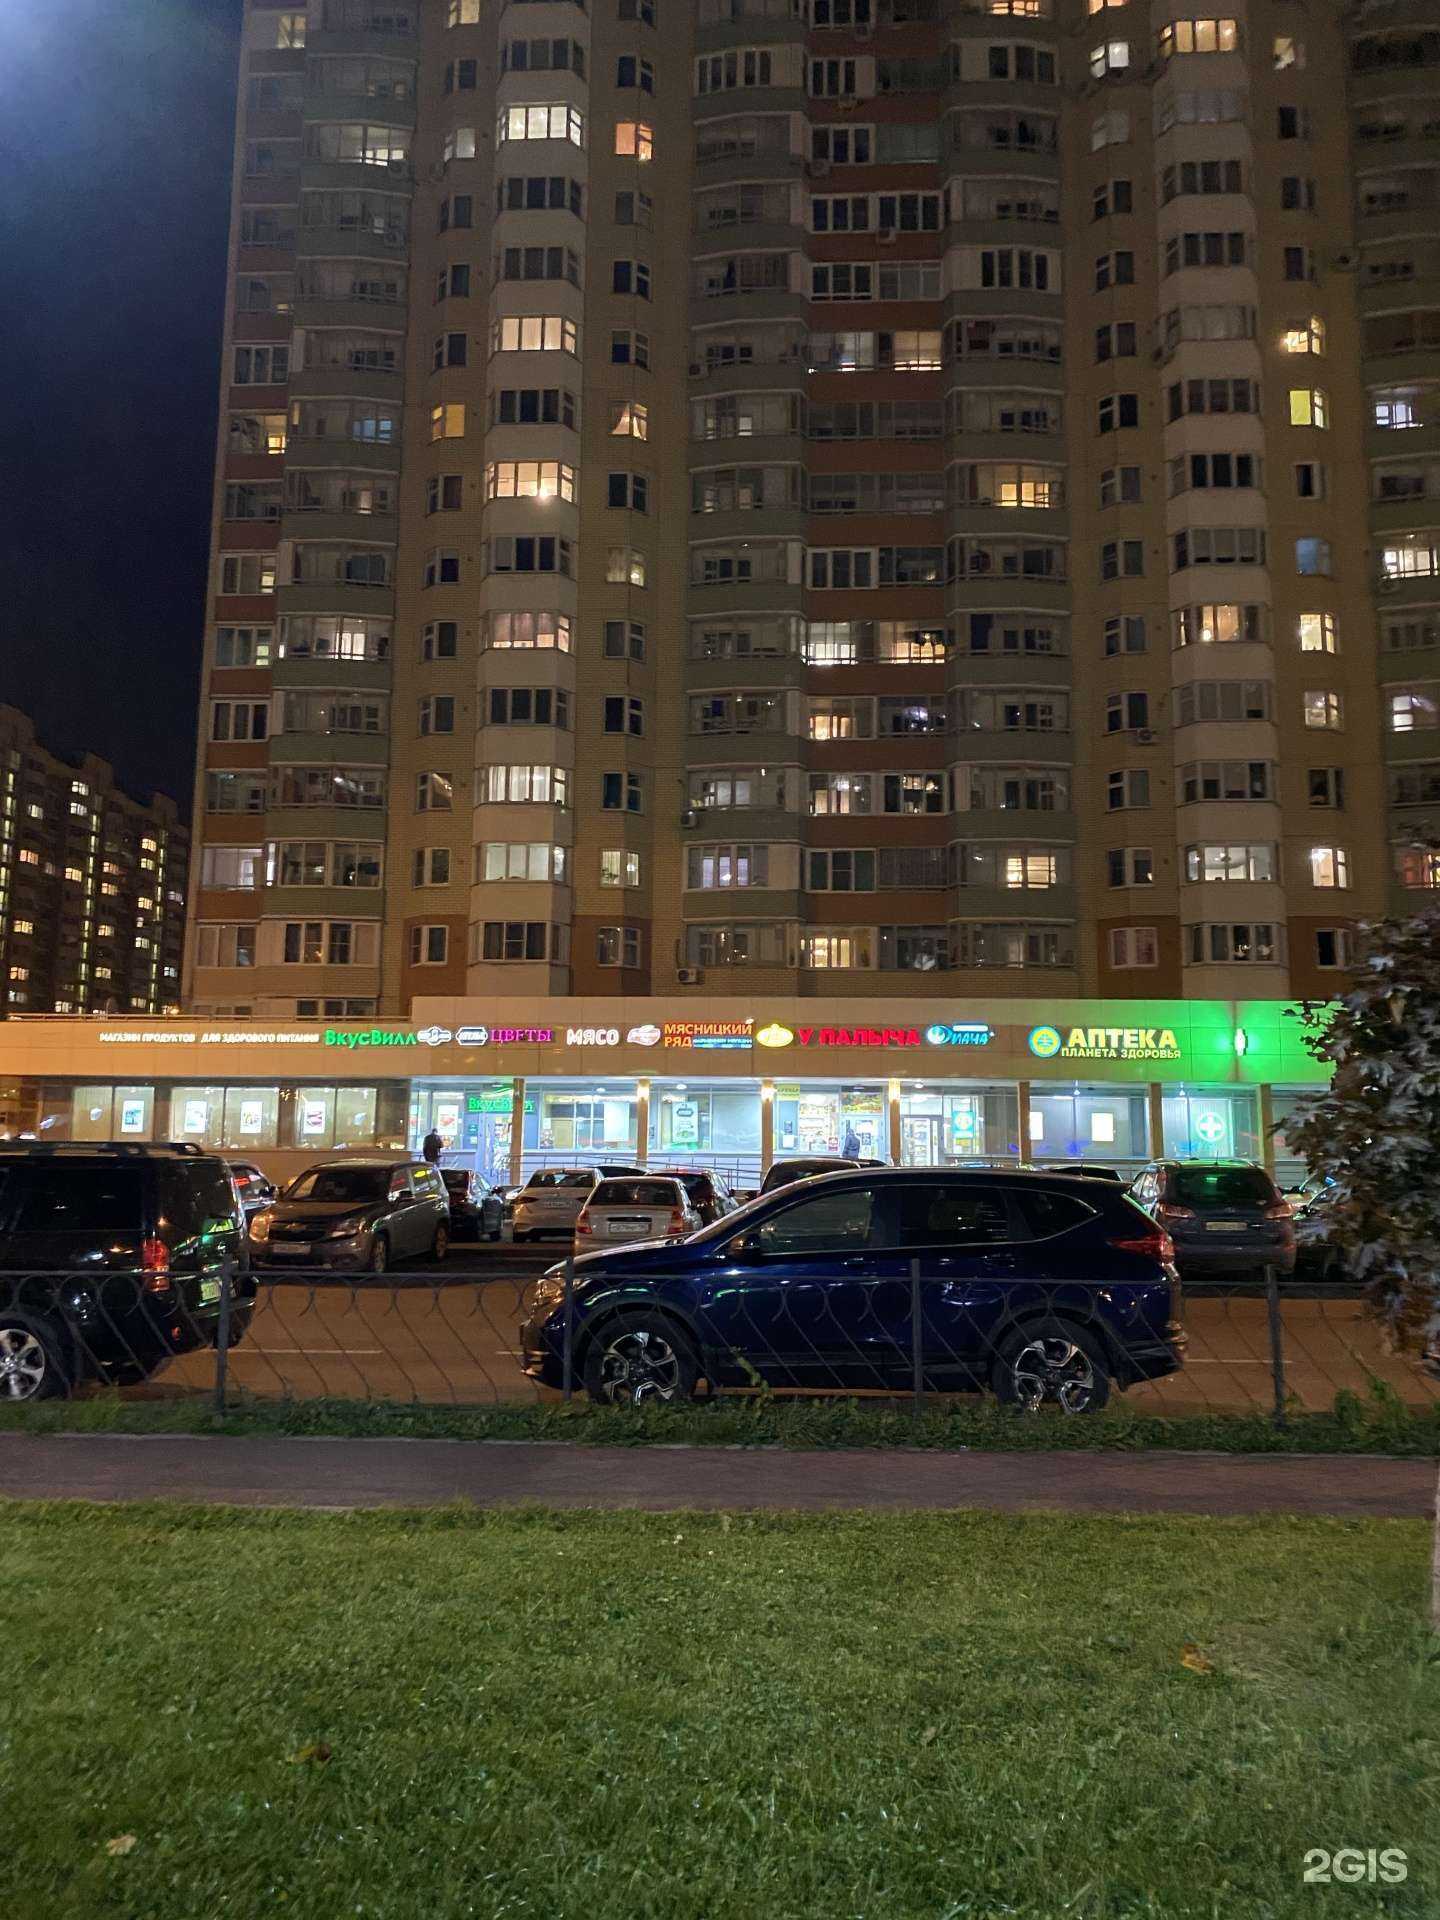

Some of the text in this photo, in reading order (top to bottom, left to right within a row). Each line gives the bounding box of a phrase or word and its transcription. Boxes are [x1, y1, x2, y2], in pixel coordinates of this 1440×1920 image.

[664, 1018, 753, 1035] МЯСНИЦКИЙ
[141, 1033, 196, 1043] ПРОДУКТОВ
[200, 1033, 221, 1043] ДЛЯ
[222, 1033, 276, 1043] ЗДОРОВОГО
[324, 1028, 417, 1049] ВкусВилл
[490, 1029, 552, 1044] ЦВЕТЫ
[566, 1028, 619, 1046] МЯСО
[664, 1036, 692, 1048] РЯД
[799, 1029, 921, 1046] У ПАЛЫЧА
[1068, 1028, 1178, 1049] АПТЕКА
[1061, 1047, 1181, 1060] ПЛАНЕТА ЗДОРОВЬЯ
